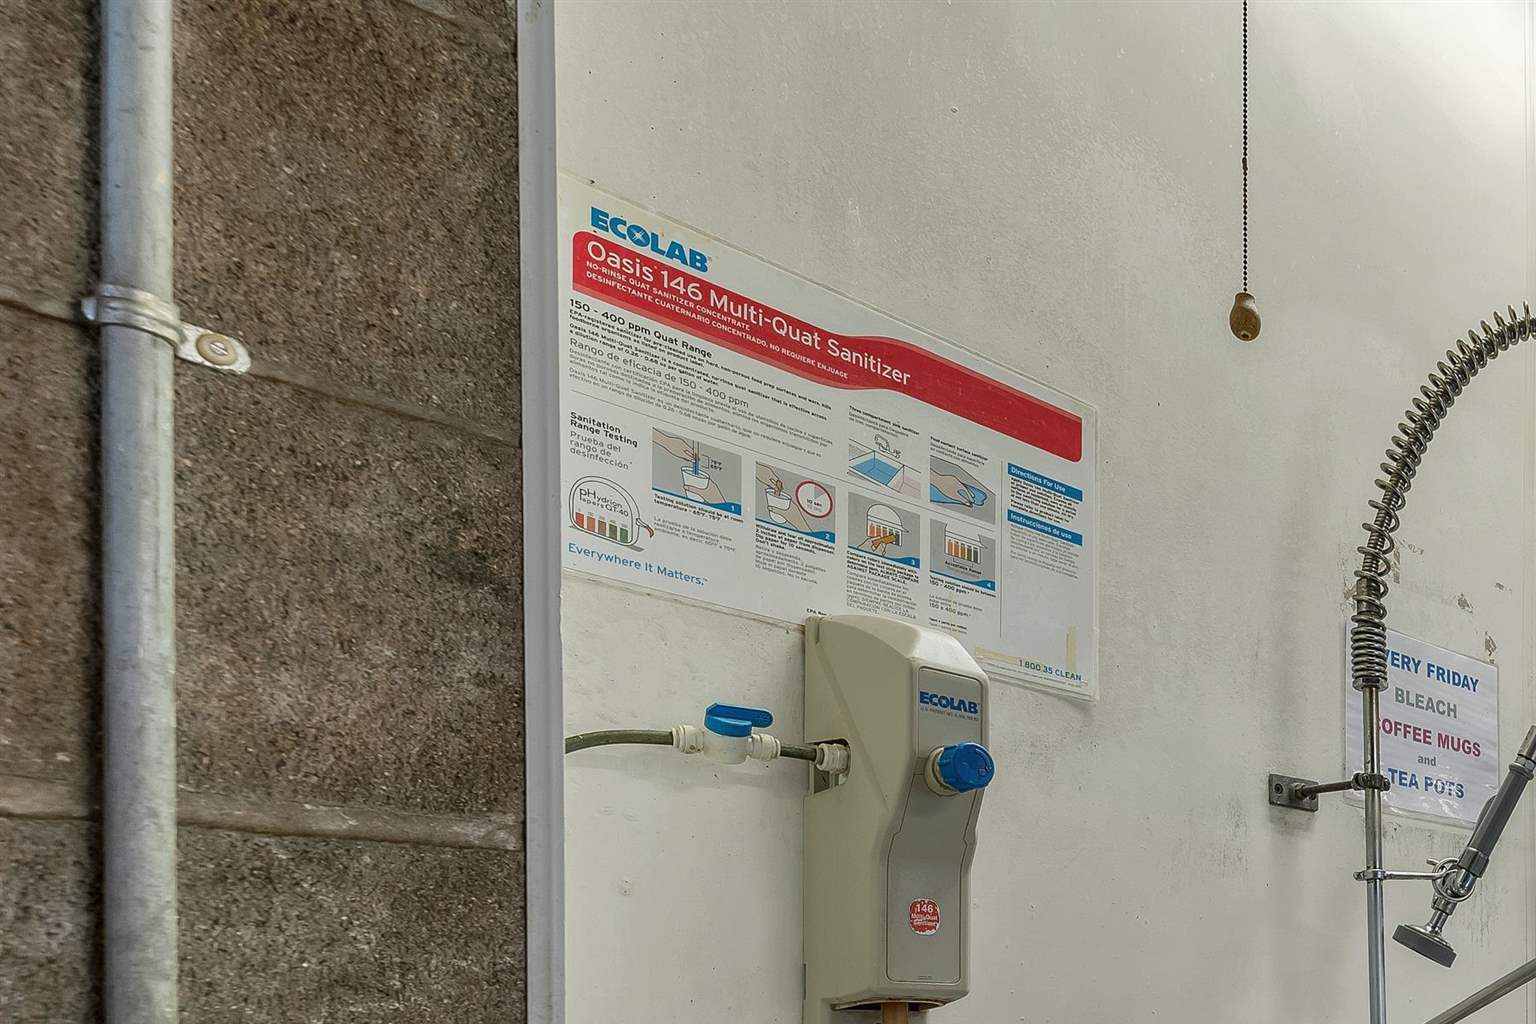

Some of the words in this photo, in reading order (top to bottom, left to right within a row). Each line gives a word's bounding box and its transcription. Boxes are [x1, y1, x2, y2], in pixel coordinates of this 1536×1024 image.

[590, 205, 708, 274] ECOLAB
[586, 260, 626, 282] NO-RINSE
[629, 277, 650, 292] QUAT
[652, 286, 694, 309] SANITIZER
[696, 304, 749, 331] CONCENTRATE
[586, 270, 652, 303] DESINFECTANTE
[655, 297, 709, 325] CUATERNARIO
[770, 342, 779, 352] NO
[781, 347, 815, 366] REQUIERE
[587, 238, 653, 283] Oasis
[660, 268, 702, 302] 146
[710, 288, 820, 350] Multi-Quat
[827, 336, 910, 385] Sanitizer
[569, 298, 589, 313] 150
[601, 310, 624, 326] 400
[628, 322, 650, 336] ppm
[654, 329, 678, 346] Quat
[681, 340, 711, 359] Range
[570, 337, 603, 358] Rango
[606, 350, 619, 362] de
[622, 356, 661, 377] eficacia
[664, 371, 675, 382] de
[680, 376, 696, 390] 150
[705, 386, 725, 400] 400
[728, 396, 748, 409] ppm
[570, 411, 620, 434] Sanitation
[570, 419, 599, 436] Range
[604, 430, 637, 447] Testing
[569, 430, 603, 447] Prueba
[606, 441, 620, 453] del
[570, 439, 596, 454] rango
[600, 447, 611, 457] de
[570, 445, 628, 470] desinfección
[1011, 466, 1041, 483] Directions
[1043, 478, 1052, 487] For
[1054, 482, 1065, 492] Use
[580, 489, 622, 508] pHydrion
[1010, 512, 1050, 532] Instrucciones
[1052, 527, 1059, 535] de
[1061, 530, 1071, 539] uso
[568, 543, 641, 570] Everywhere
[644, 561, 653, 573] It
[657, 564, 705, 586] Matters.
[1024, 661, 1040, 671] 800
[1042, 665, 1052, 674] 35
[1055, 668, 1081, 681] CLEAN
[1386, 649, 1421, 674] VERY
[1427, 662, 1479, 693] FRIDAY
[919, 691, 978, 714] ECOLAB
[1395, 687, 1458, 718] BLEACH
[1437, 732, 1482, 757] MUGS
[1418, 755, 1437, 767] and
[1388, 768, 1419, 789] TEA
[1424, 776, 1465, 799] POTS
[916, 904, 934, 913] 146
